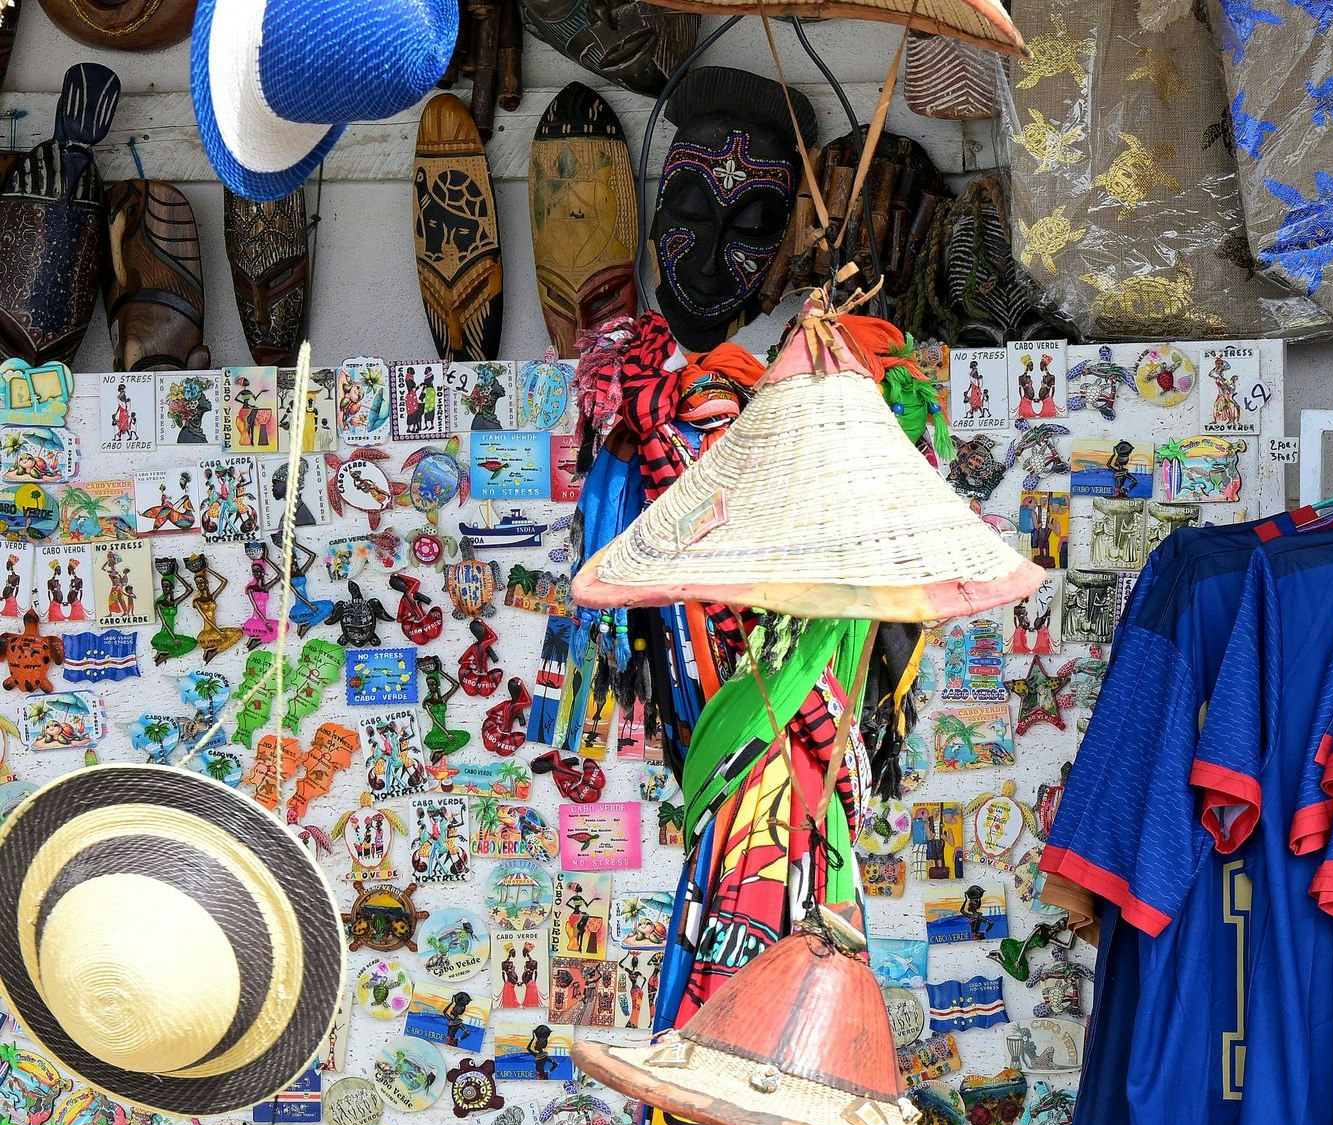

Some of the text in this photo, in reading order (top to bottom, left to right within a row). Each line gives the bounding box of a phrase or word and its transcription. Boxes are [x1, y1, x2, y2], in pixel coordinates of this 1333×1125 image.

[1014, 341, 1060, 351] CABO VERDE
[954, 350, 1005, 361] NO STRESS
[103, 374, 153, 384] NO STRESS
[222, 368, 233, 449] CABO VERDE
[952, 417, 1005, 428] CABO VERDE
[101, 441, 152, 451] CABO VERDE
[199, 456, 252, 469] CABO VERDE
[1072, 486, 1113, 495] CABO VERDE
[516, 526, 536, 534] INDIA
[5, 541, 27, 551] VERDE
[95, 541, 143, 552] NO STRESS
[328, 535, 372, 547] CABO VERDE
[42, 545, 86, 555] CABO VERDE
[99, 615, 149, 625] CABO VERDE
[358, 652, 404, 661] NO STRESS
[354, 692, 408, 703] CABO VERDE
[941, 688, 1006, 701] CABO VERDE
[360, 709, 414, 727] CABO VERDE
[412, 797, 464, 807] CABO VERDE
[471, 839, 525, 856] CABO VERDE
[572, 858, 630, 867] NO STRESS
[963, 851, 1015, 873] CABO VERDE
[345, 868, 398, 881] CABO VERDE
[551, 873, 564, 952] CABO VERDE
[517, 932, 539, 940] VERDE
[433, 955, 482, 976] Cabo Verde
